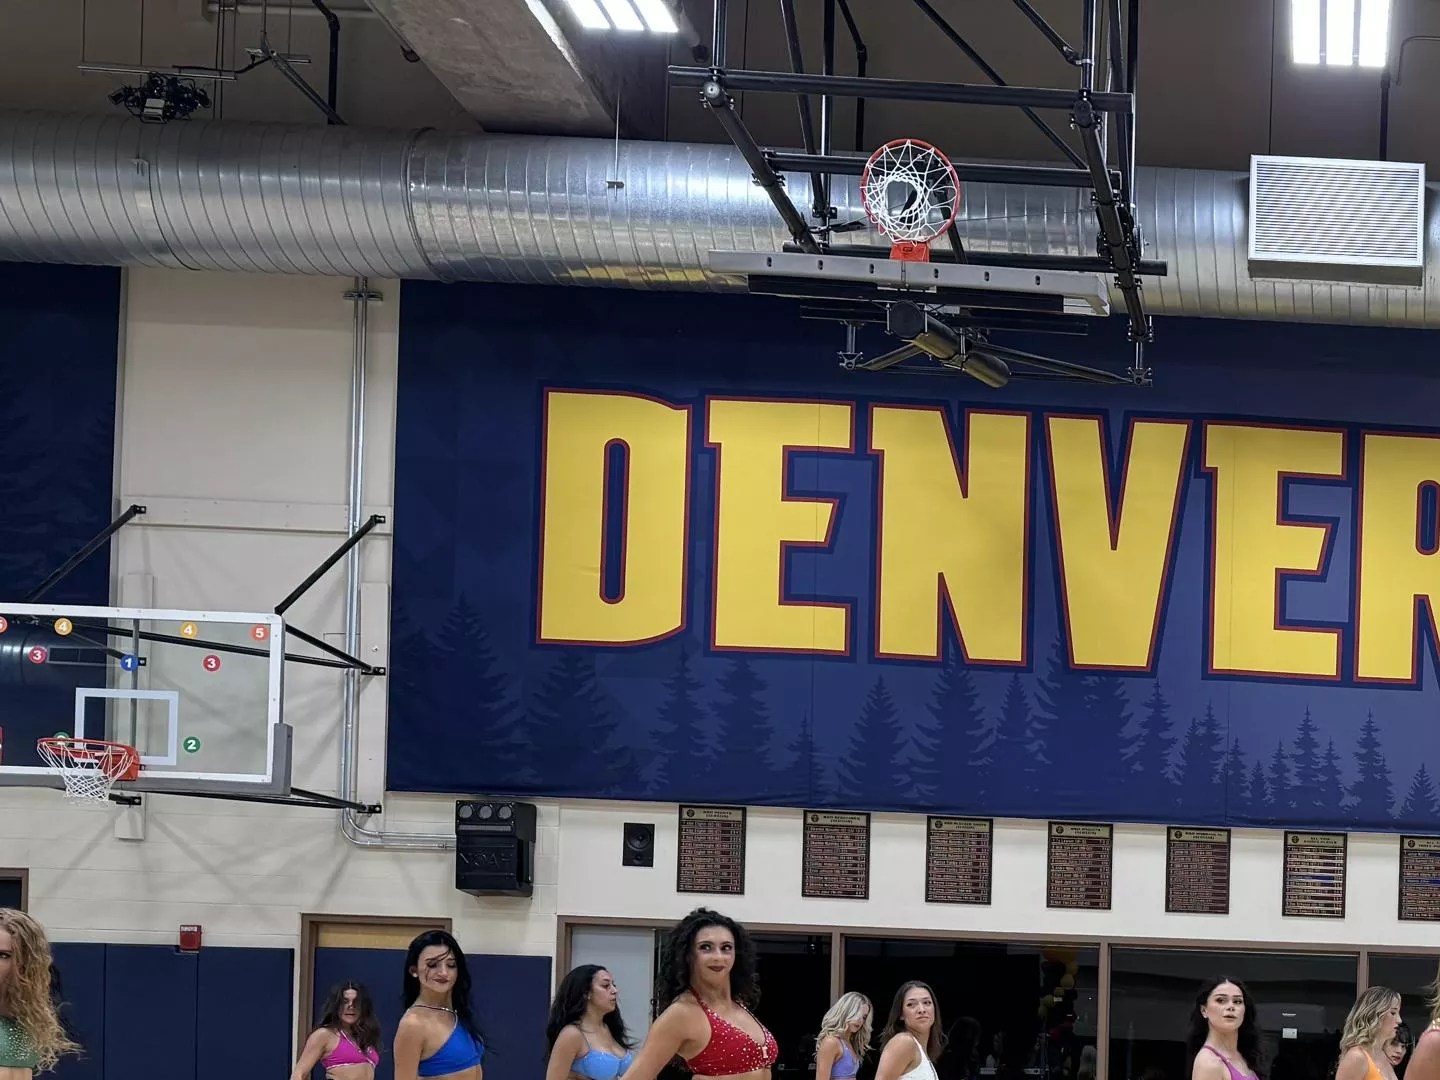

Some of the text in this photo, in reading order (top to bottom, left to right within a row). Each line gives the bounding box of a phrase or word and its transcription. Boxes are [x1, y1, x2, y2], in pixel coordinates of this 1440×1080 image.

[58, 621, 67, 631] 4
[184, 625, 193, 635] 4
[255, 627, 264, 638] 5
[32, 650, 42, 660] 3
[124, 658, 132, 668] 1
[207, 658, 216, 668] 3
[187, 739, 197, 750] 2
